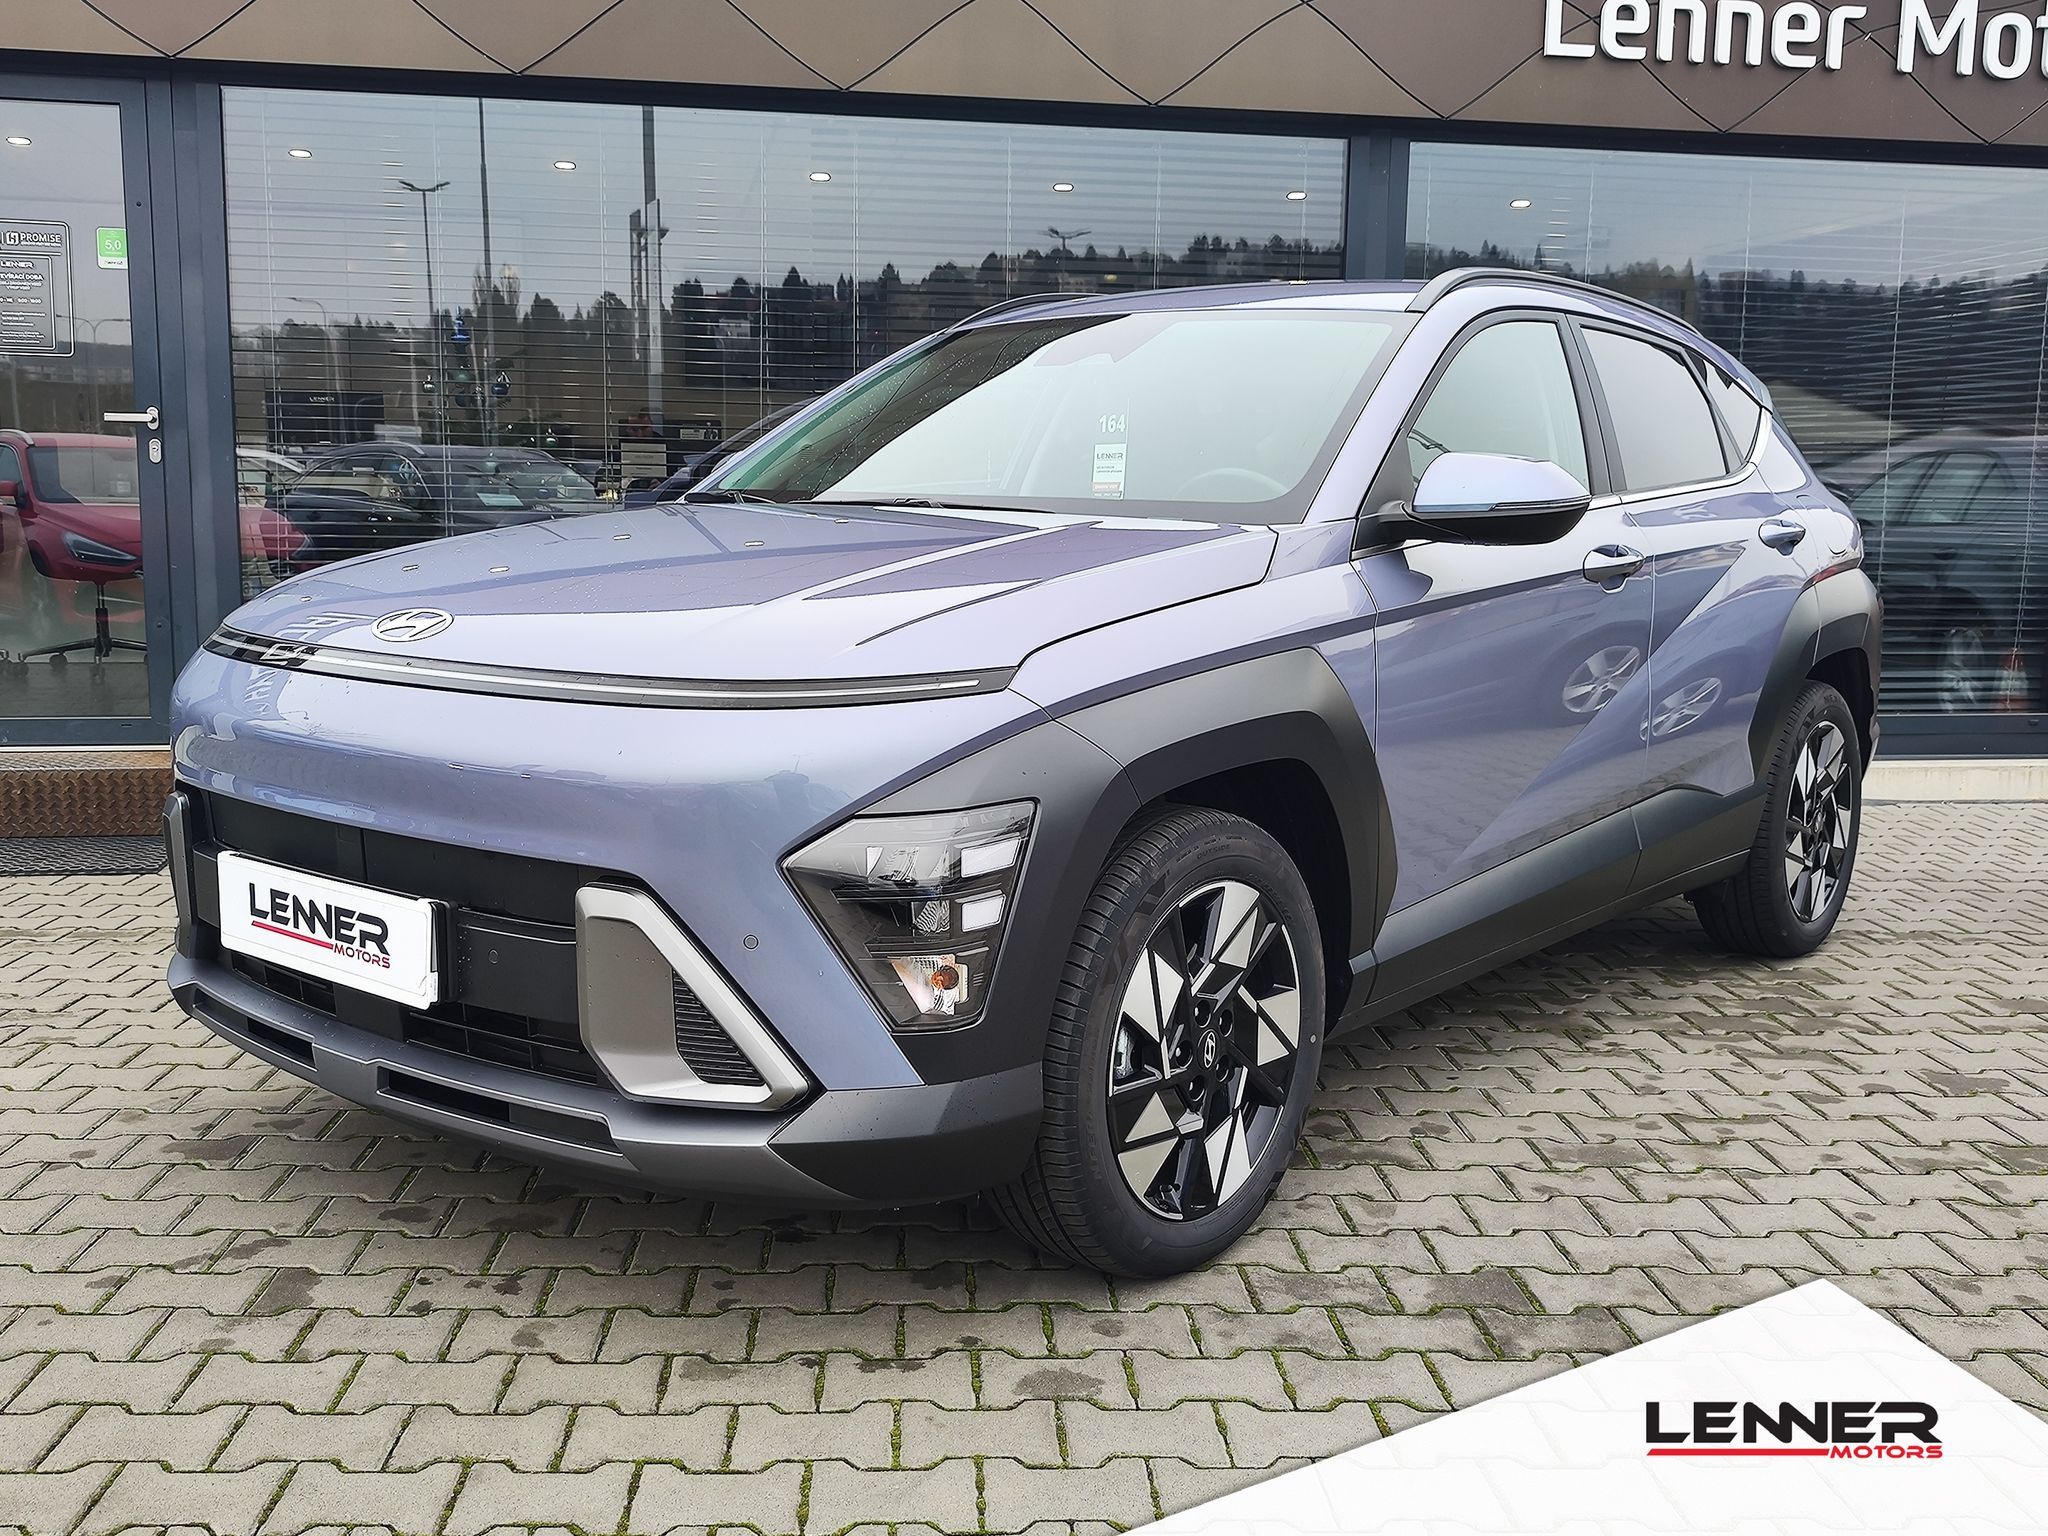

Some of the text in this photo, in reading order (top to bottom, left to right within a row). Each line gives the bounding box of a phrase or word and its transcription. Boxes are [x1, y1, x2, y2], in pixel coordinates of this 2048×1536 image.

[1543, 0, 1869, 71] Lenner
[20, 232, 62, 242] PROMISE
[1099, 414, 1126, 433] 164
[1096, 452, 1124, 460] LENNER
[249, 882, 391, 957] LENNER
[333, 942, 391, 969] MOTORS
